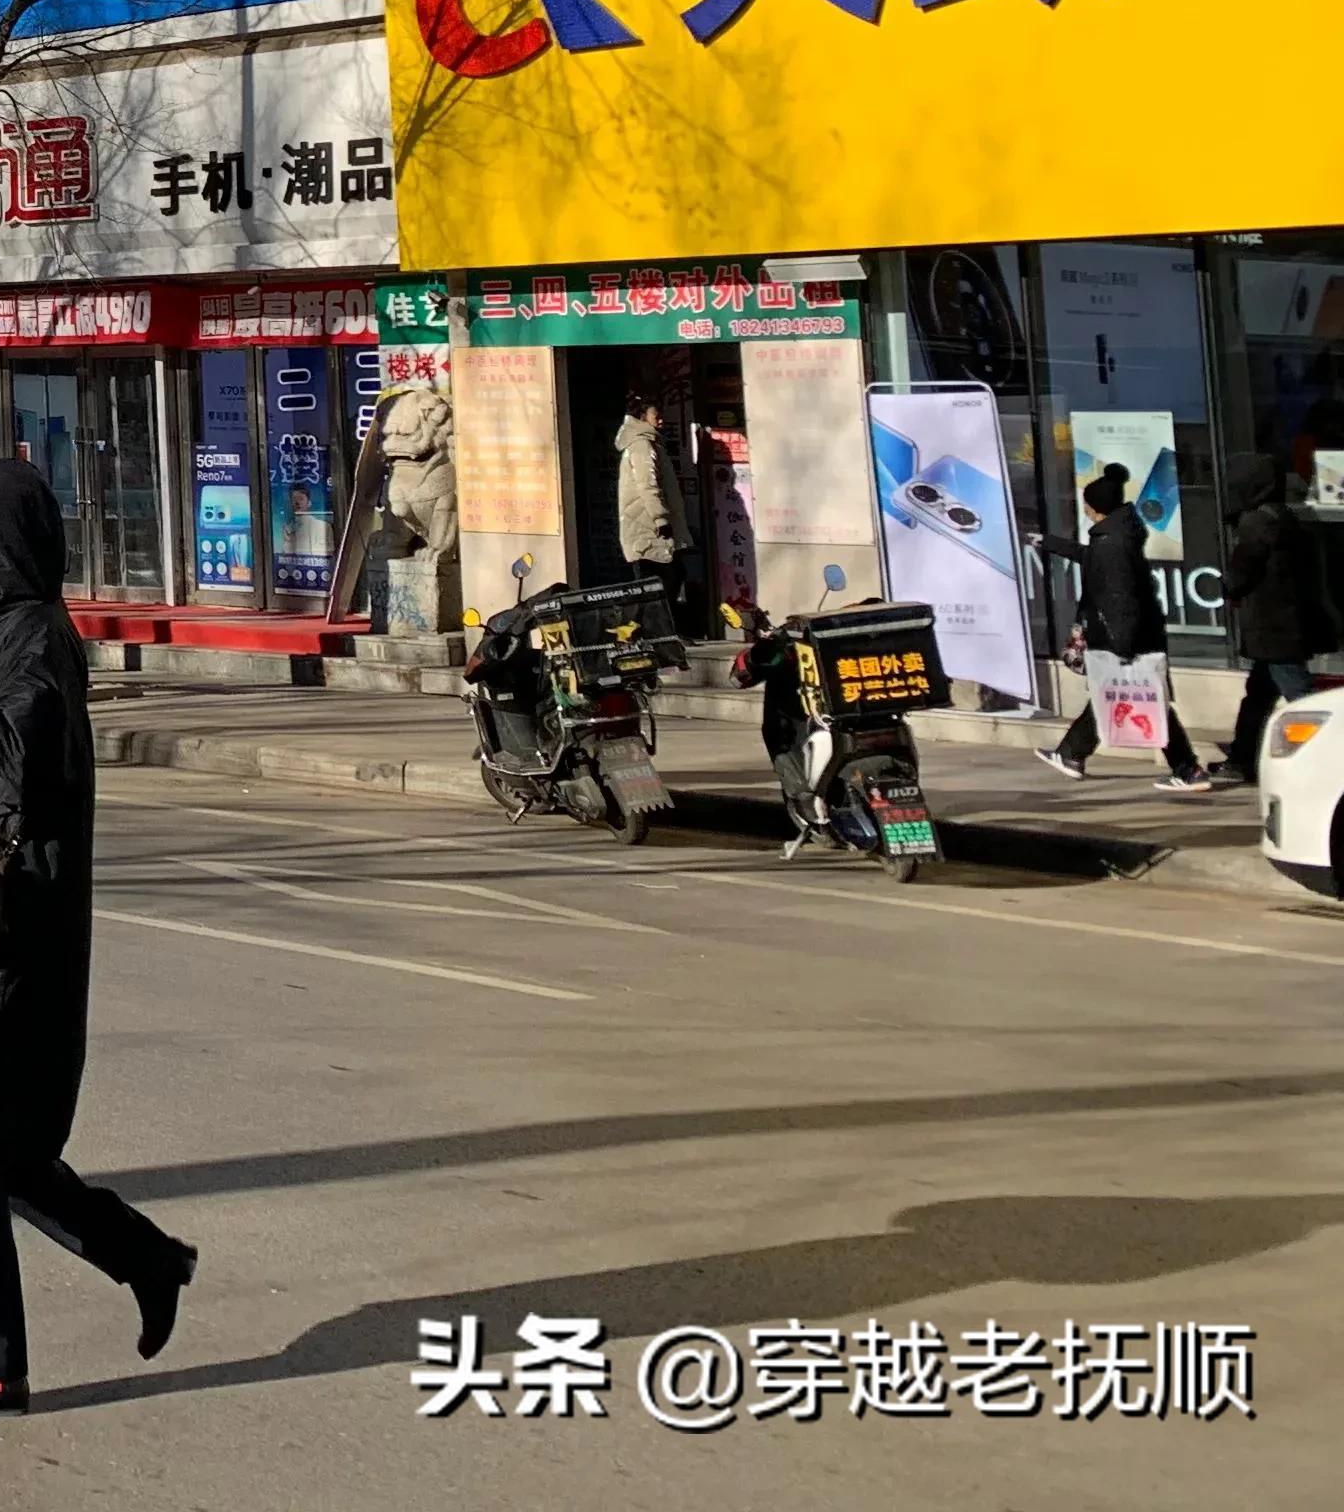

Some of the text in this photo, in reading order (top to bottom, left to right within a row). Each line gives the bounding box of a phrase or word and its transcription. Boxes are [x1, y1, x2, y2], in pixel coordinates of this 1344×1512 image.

[387, 353, 436, 382] 楼梯
[837, 652, 925, 679] 美团外卖
